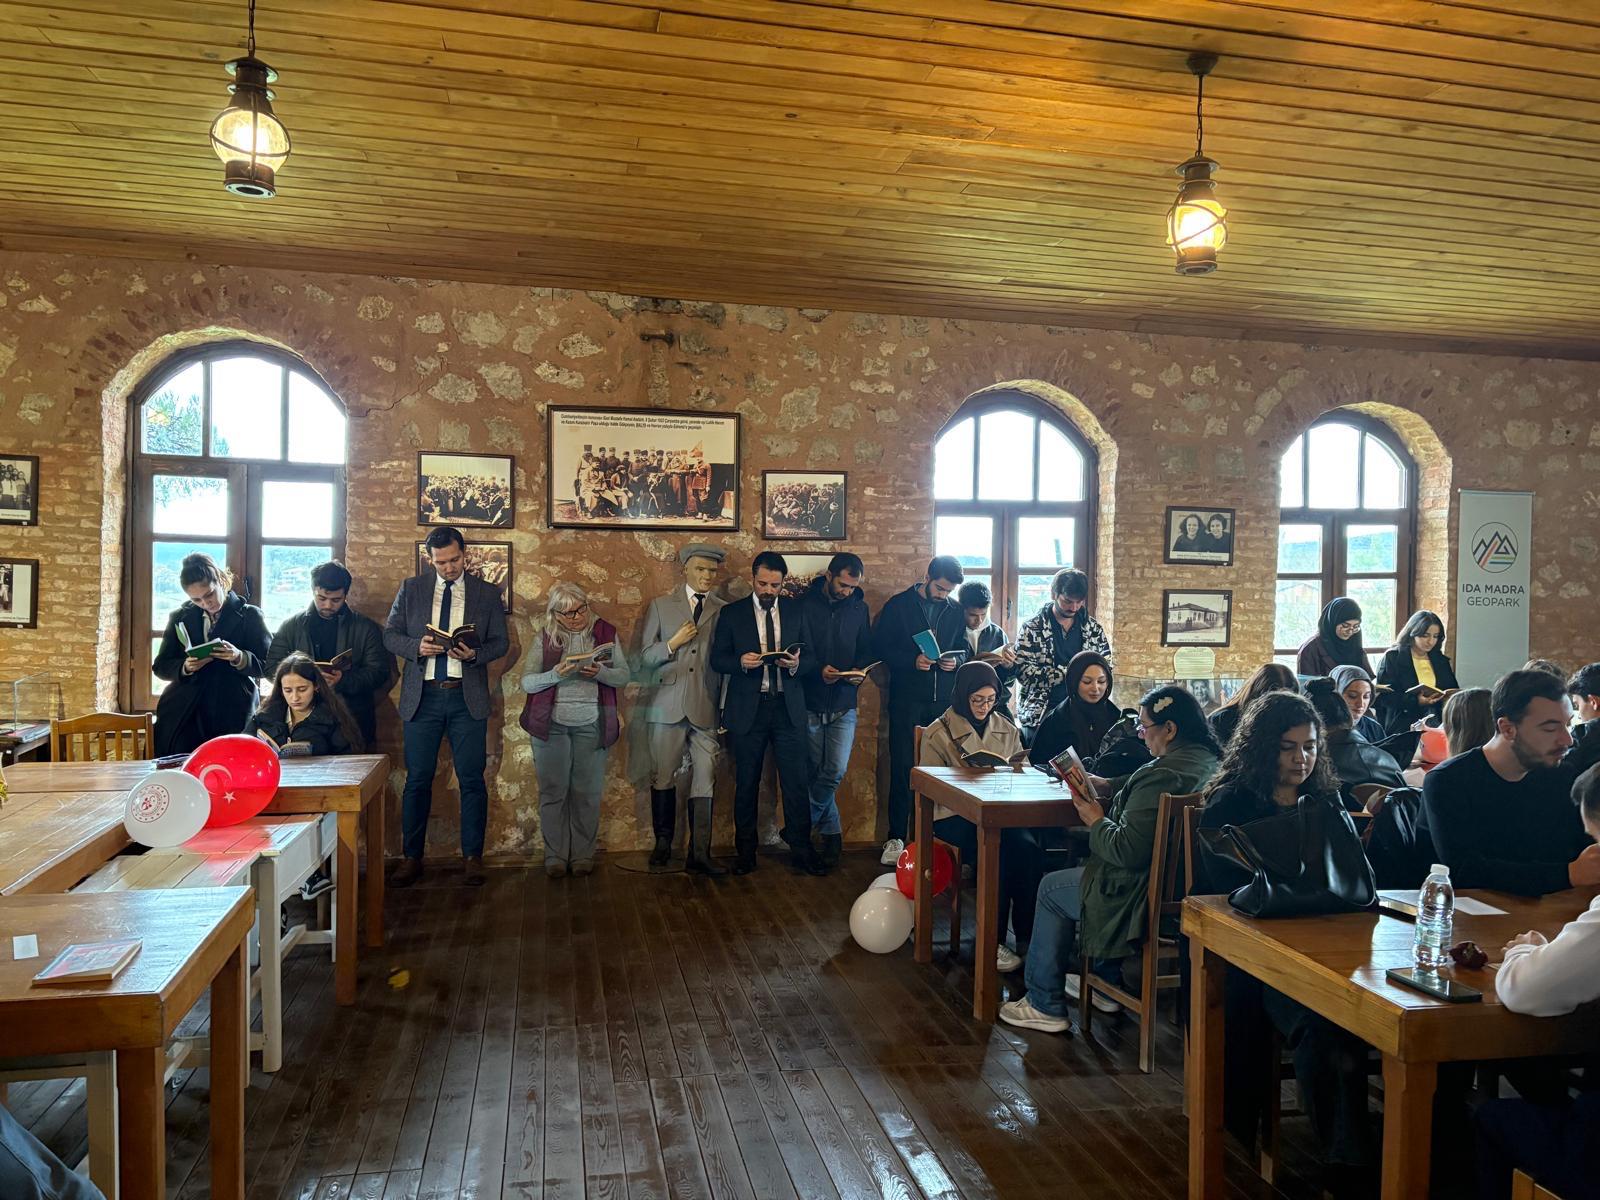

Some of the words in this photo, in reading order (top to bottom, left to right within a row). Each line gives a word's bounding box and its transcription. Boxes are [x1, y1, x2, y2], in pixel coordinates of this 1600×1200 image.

[1462, 583, 1481, 593] IDA
[1484, 584, 1525, 594] MADRA
[1466, 596, 1520, 607] GEOPARK
